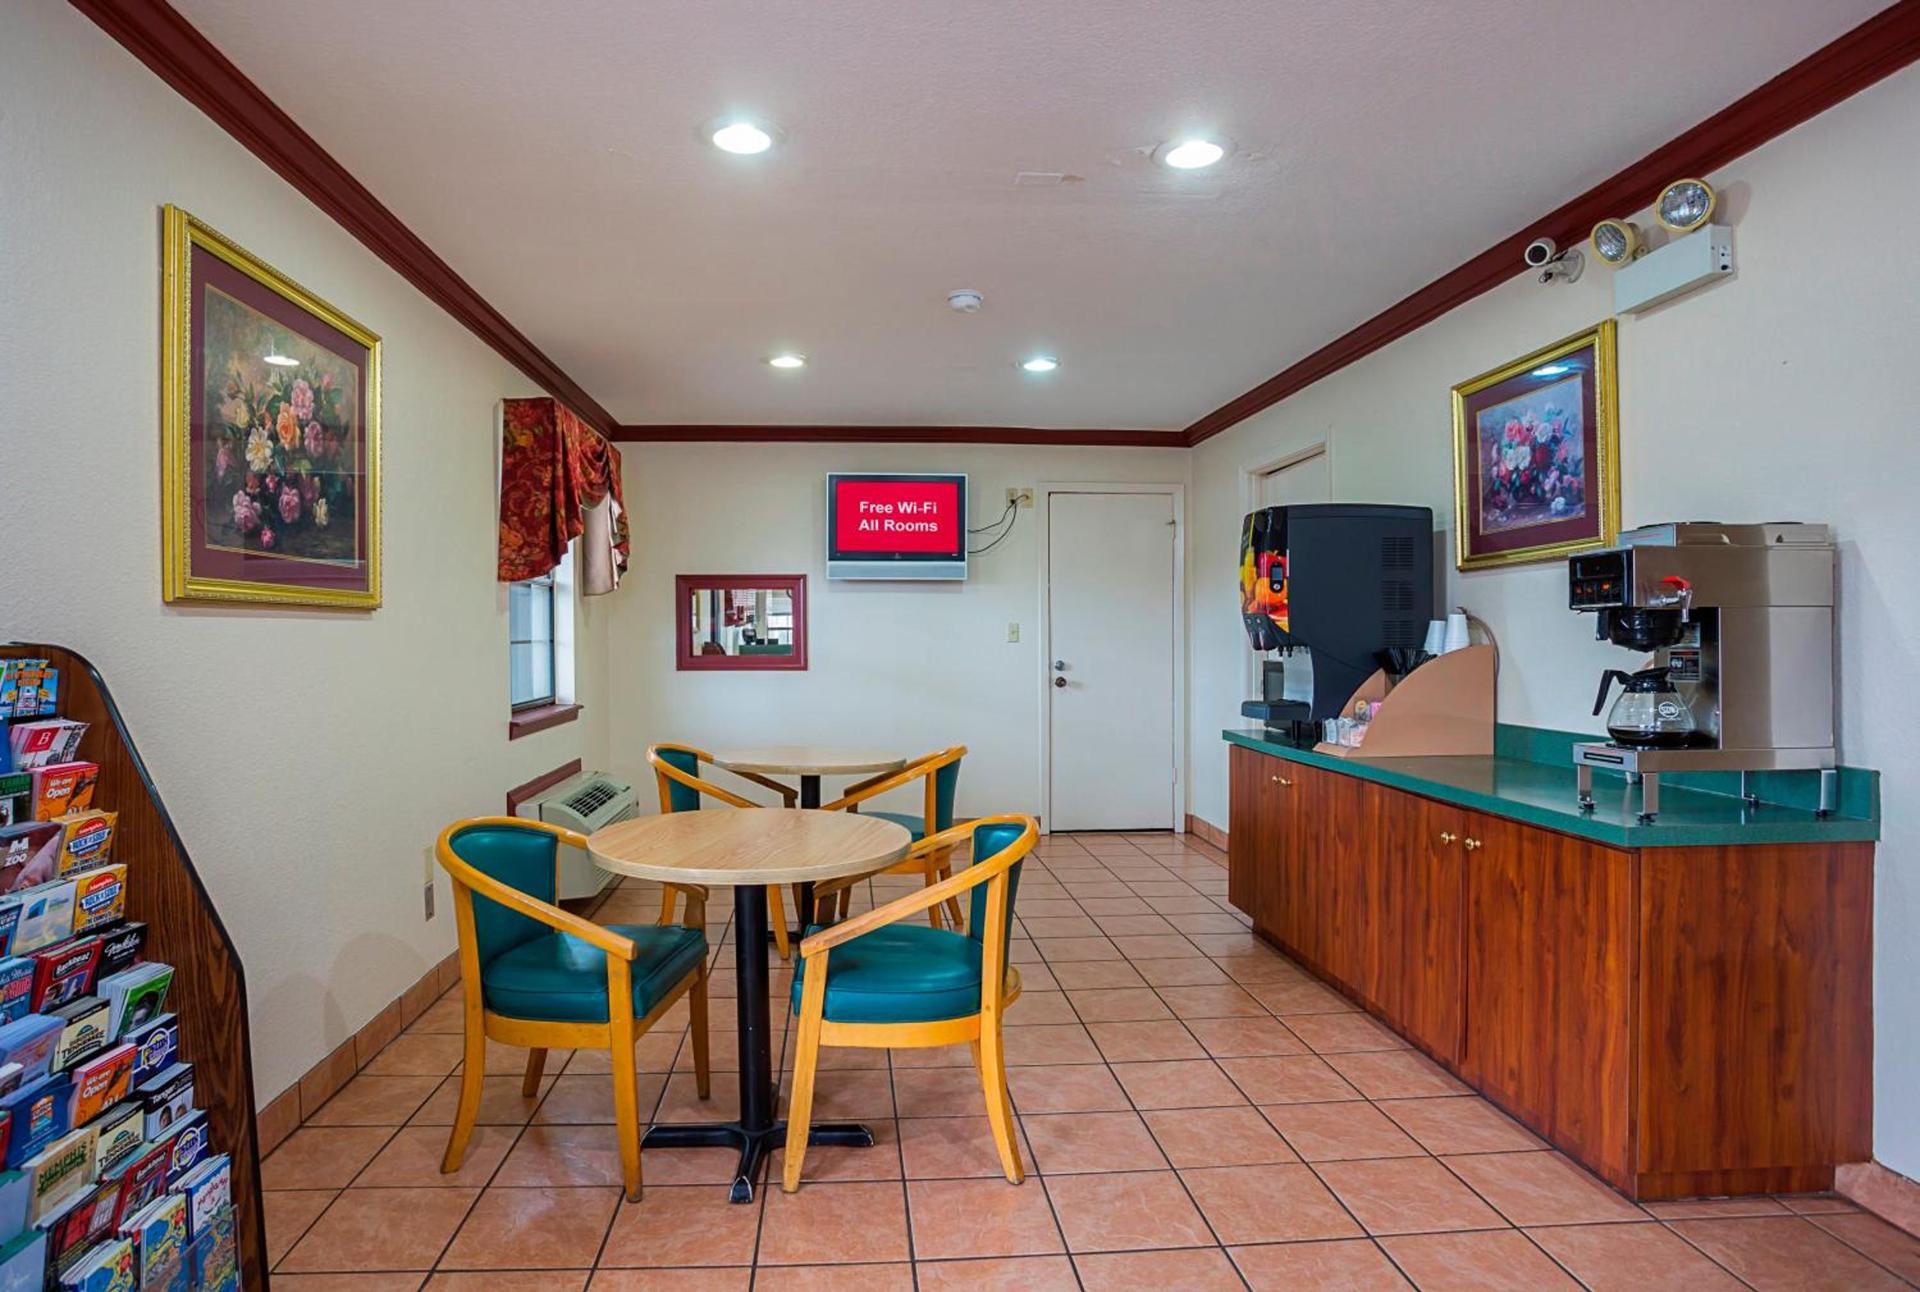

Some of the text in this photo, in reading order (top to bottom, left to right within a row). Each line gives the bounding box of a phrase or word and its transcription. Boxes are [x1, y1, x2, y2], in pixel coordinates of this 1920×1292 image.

[859, 501, 937, 514] Free Wi-Fi
[858, 519, 938, 532] All Rooms
[46, 787, 71, 799] Open
[4, 853, 28, 867] ZOO
[83, 1081, 108, 1099] Open
[152, 1084, 175, 1104] Tanger
